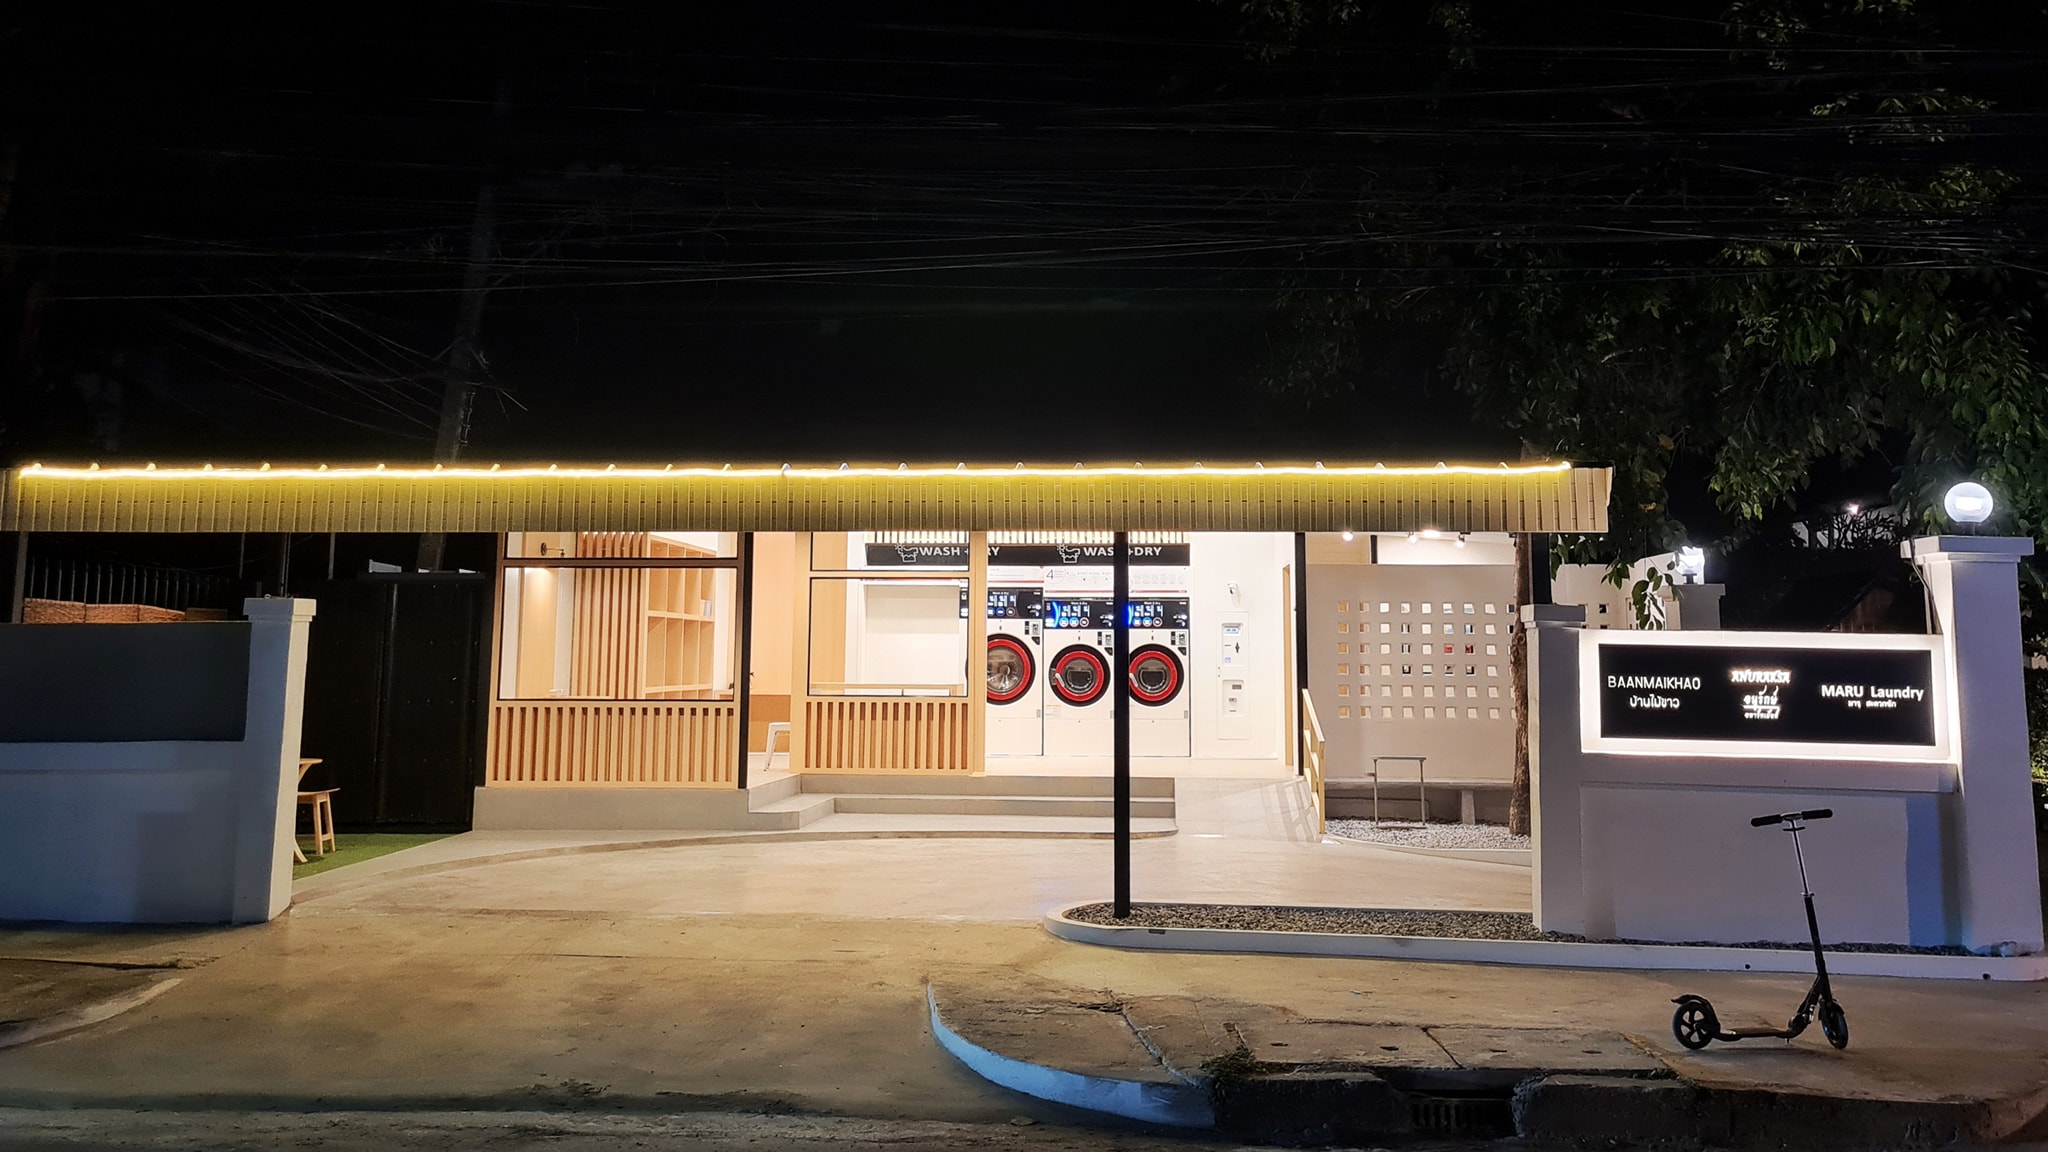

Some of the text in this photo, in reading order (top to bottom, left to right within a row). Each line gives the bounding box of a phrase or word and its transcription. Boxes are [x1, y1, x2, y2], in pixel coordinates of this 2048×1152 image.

[919, 546, 960, 557] WASH
[1083, 546, 1115, 557] WAS
[1607, 675, 1701, 690] BAANMAIKHAO
[1821, 684, 1924, 702] MARU Laundry
[1629, 693, 1680, 709] บ้านไม้ขาว
